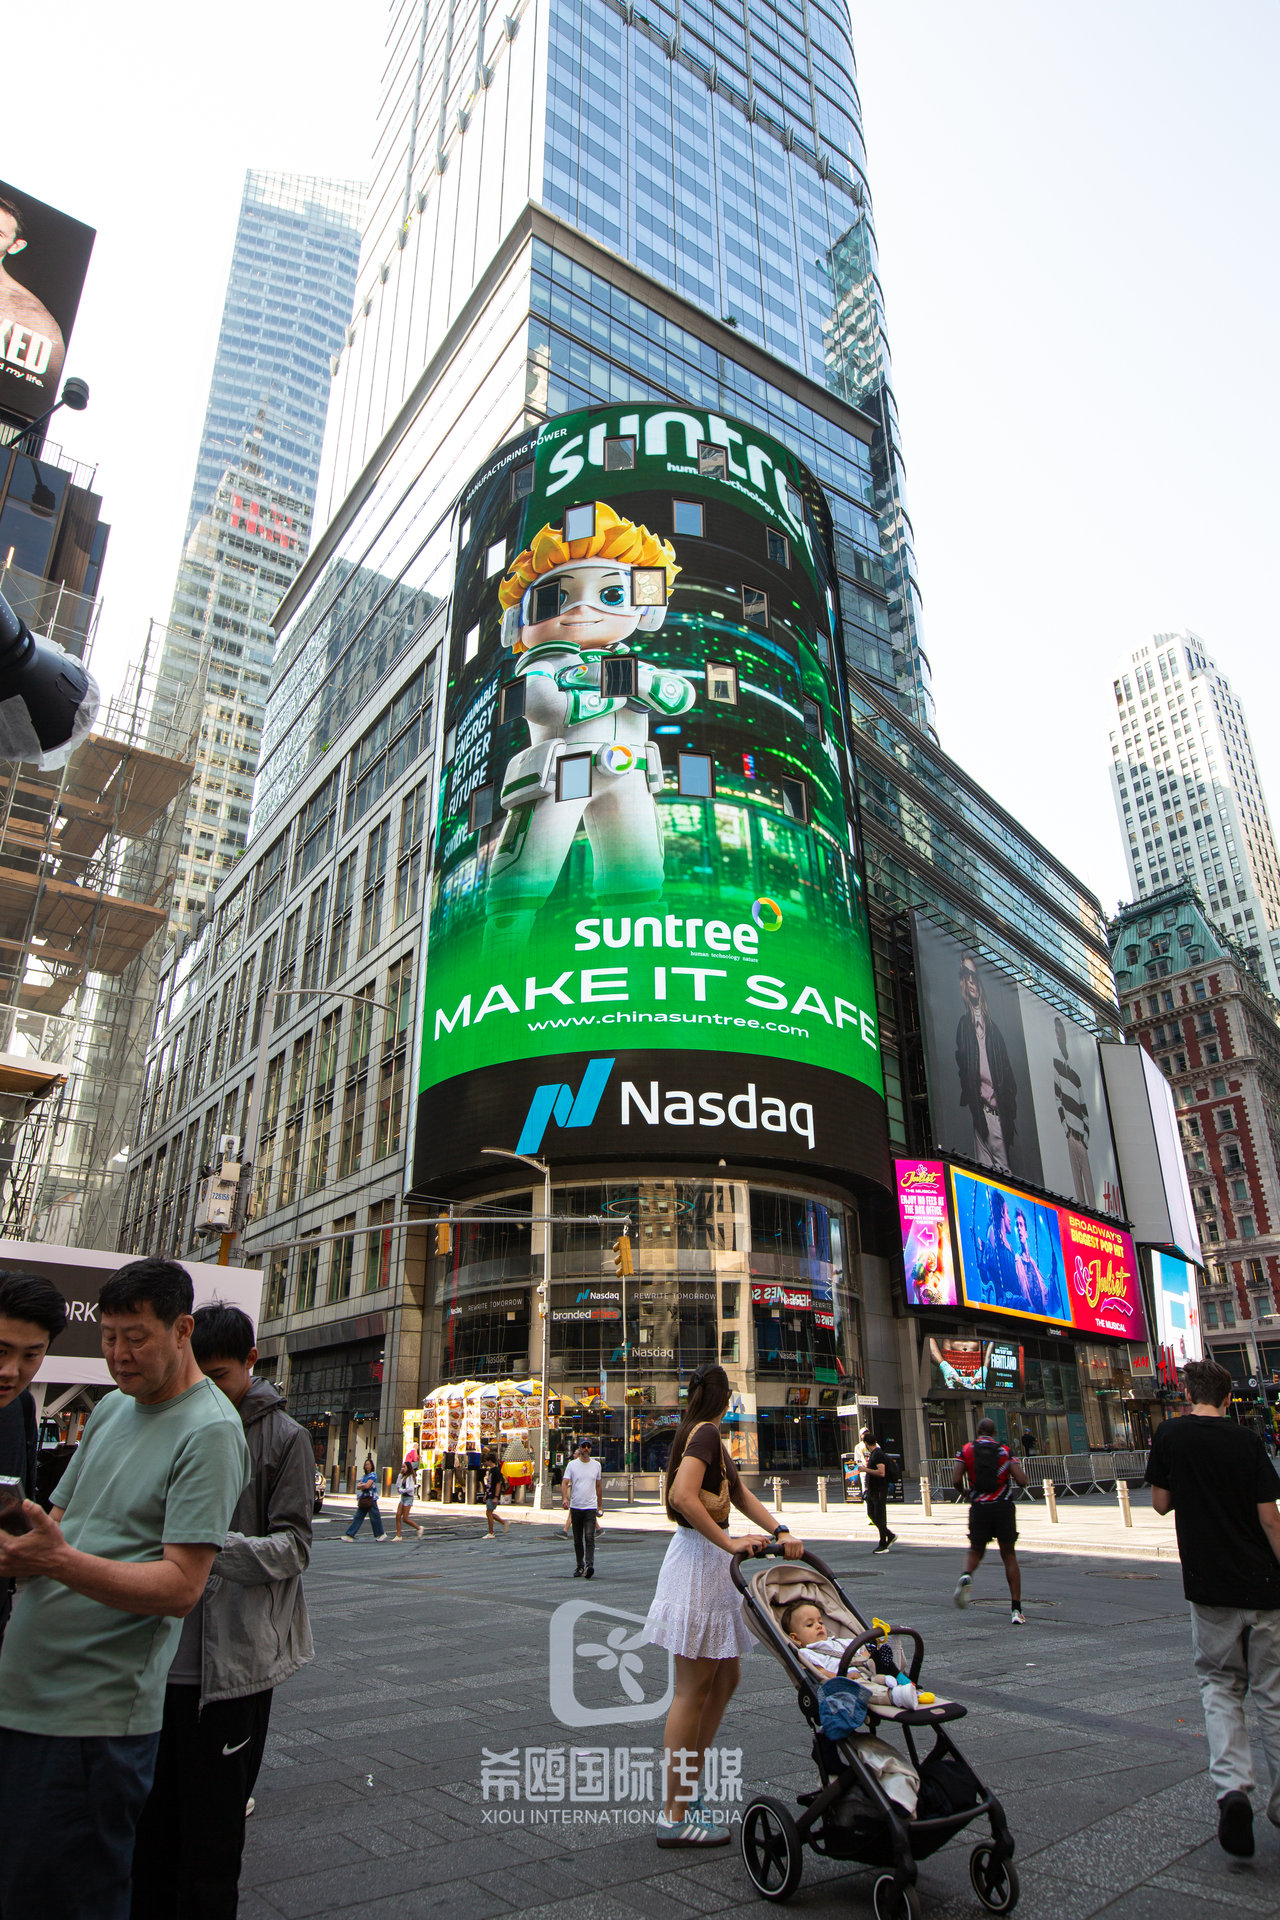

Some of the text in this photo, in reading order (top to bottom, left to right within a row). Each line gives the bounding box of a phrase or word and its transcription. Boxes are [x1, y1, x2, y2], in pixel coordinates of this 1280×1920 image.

[5, 366, 25, 378] my
[465, 428, 568, 505] MANUFACTURING POWER
[457, 679, 498, 741] SUSTAINABLE
[454, 701, 496, 766] ENERGY
[451, 732, 491, 793] BETTER
[447, 761, 488, 821] FUTURE
[574, 914, 759, 955] suntree
[711, 952, 740, 962] technology
[742, 955, 759, 963] nature
[434, 966, 877, 1051] MAKE IT SAFE
[527, 1010, 810, 1039] www.chinasuntree.com
[621, 1081, 815, 1150] Nasdaq
[901, 1171, 941, 1187] Juliet
[1069, 1216, 1123, 1244] BROADWAY'S
[1071, 1228, 1124, 1258] BIGGEST POP HIT
[590, 1291, 717, 1301] Nasdaq REWRITE TOMORROW
[1086, 1259, 1131, 1308] Juliet
[468, 1302, 488, 1312] REWRITE
[490, 1298, 523, 1308] TOMORROW
[1095, 1318, 1126, 1332] THE MUSICAL
[632, 1347, 674, 1360] Nasdaq
